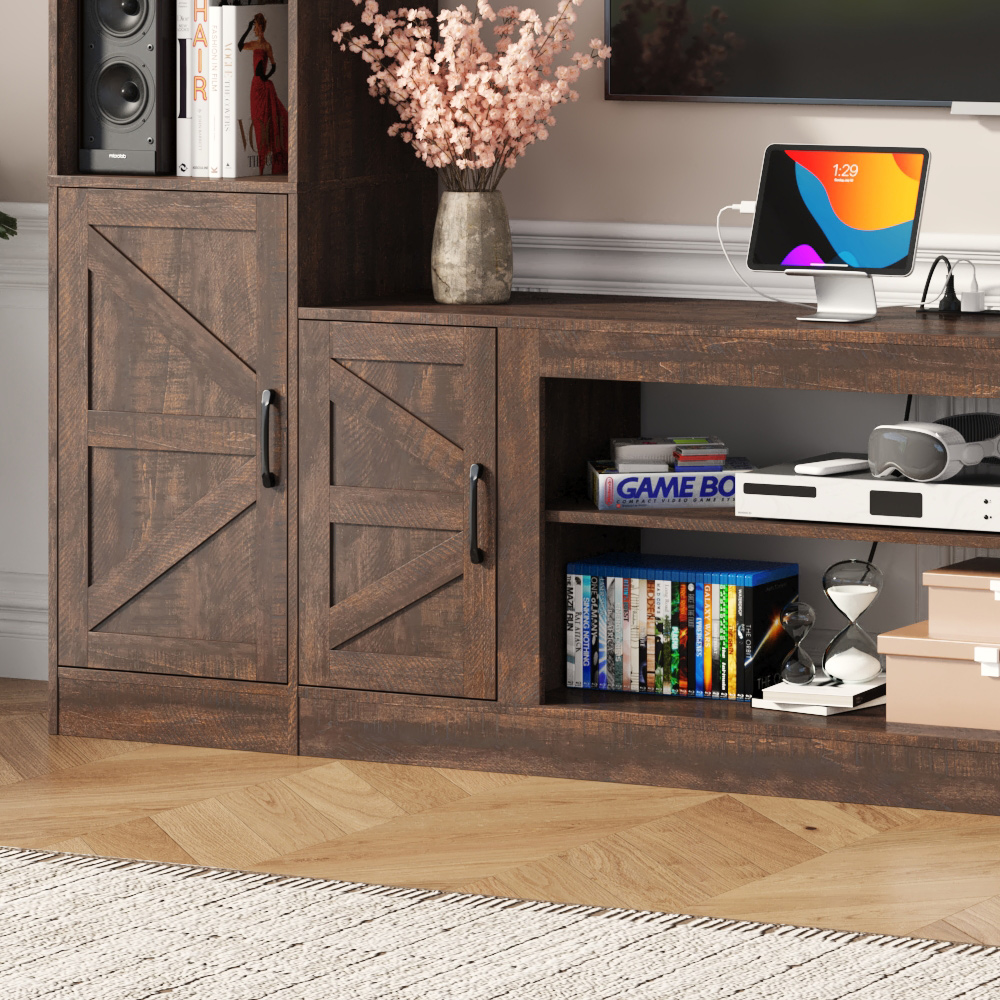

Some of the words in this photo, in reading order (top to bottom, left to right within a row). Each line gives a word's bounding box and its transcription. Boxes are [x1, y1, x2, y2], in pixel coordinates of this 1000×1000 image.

[212, 64, 218, 72] IN
[224, 42, 233, 78] VOGUE
[833, 163, 859, 177] 1:29
[616, 476, 696, 499] GAME
